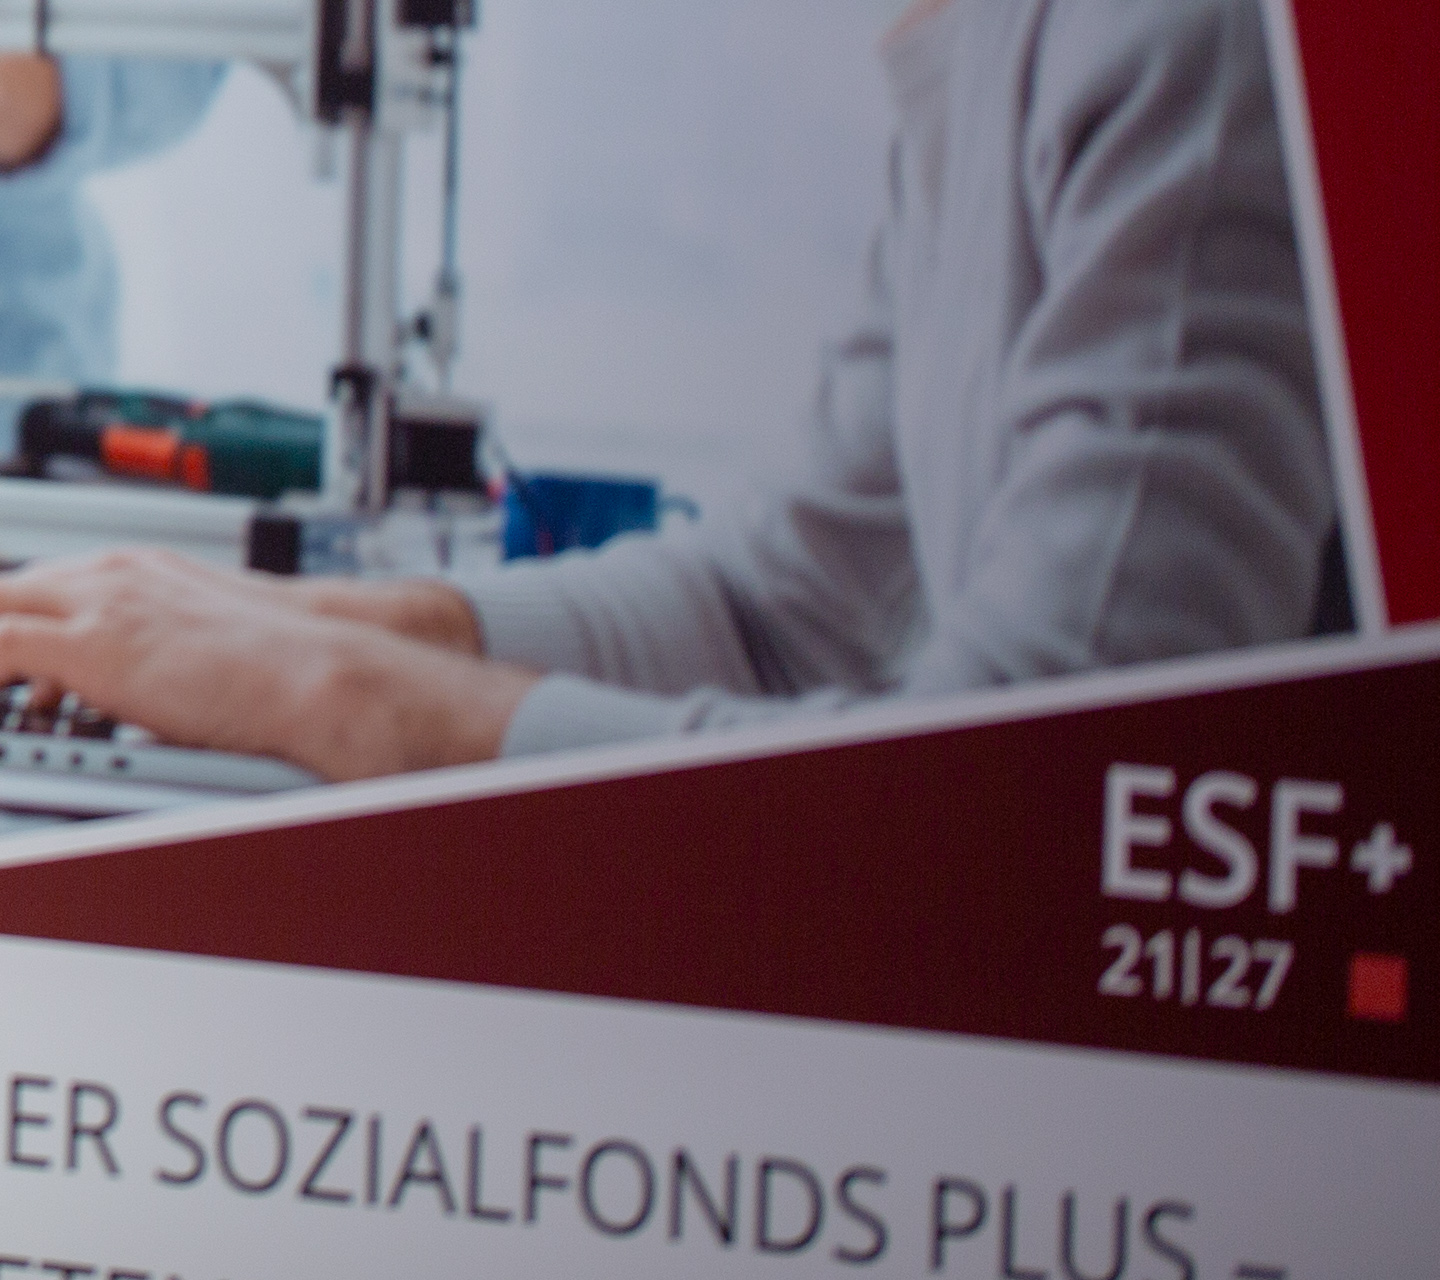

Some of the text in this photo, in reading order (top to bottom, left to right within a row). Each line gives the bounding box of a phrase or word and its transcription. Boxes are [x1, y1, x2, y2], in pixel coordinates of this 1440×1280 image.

[1100, 760, 1414, 916] ESF+
[153, 1090, 891, 1267] SOZIALFONDS
[927, 1172, 1196, 1280] PLUS
